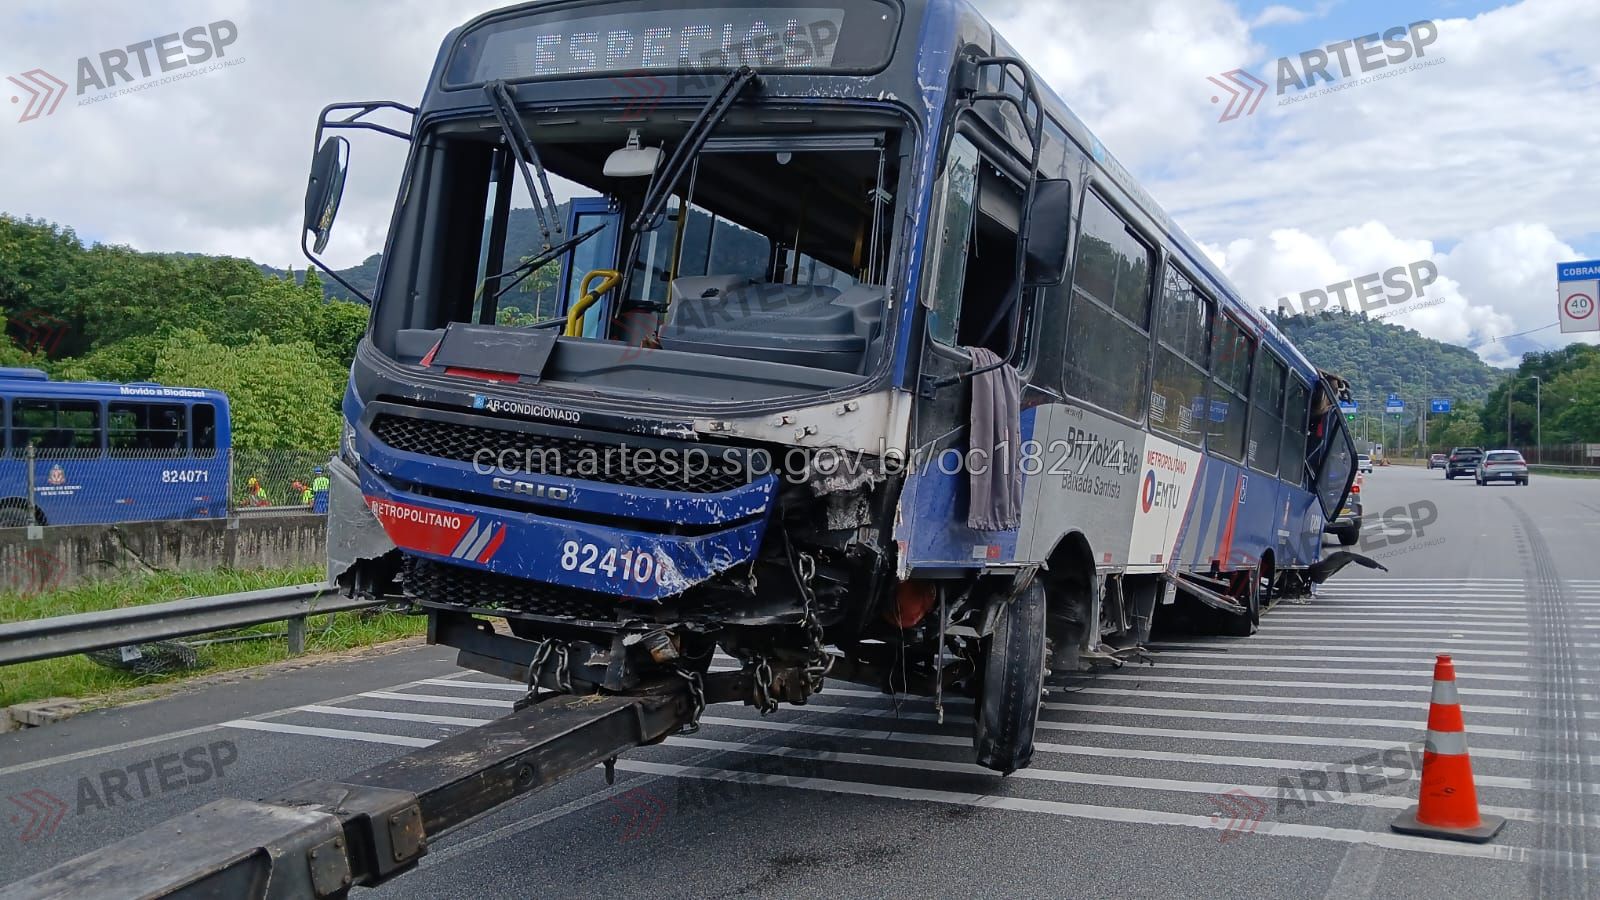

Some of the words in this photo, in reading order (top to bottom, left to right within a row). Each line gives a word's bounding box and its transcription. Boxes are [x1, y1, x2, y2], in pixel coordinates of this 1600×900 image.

[535, 18, 812, 75] ESPECIAL
[1571, 298, 1588, 309] 40
[120, 387, 155, 396] Movido
[163, 388, 205, 398] Biodiesel
[1147, 450, 1187, 475] METROPOLITANO
[162, 470, 208, 483] 824071
[1061, 470, 1093, 494] Baixada
[1093, 475, 1121, 499] Santista
[493, 478, 568, 501] CAIO
[1154, 481, 1181, 510] EMTU
[371, 501, 461, 530] METROPOLITANO
